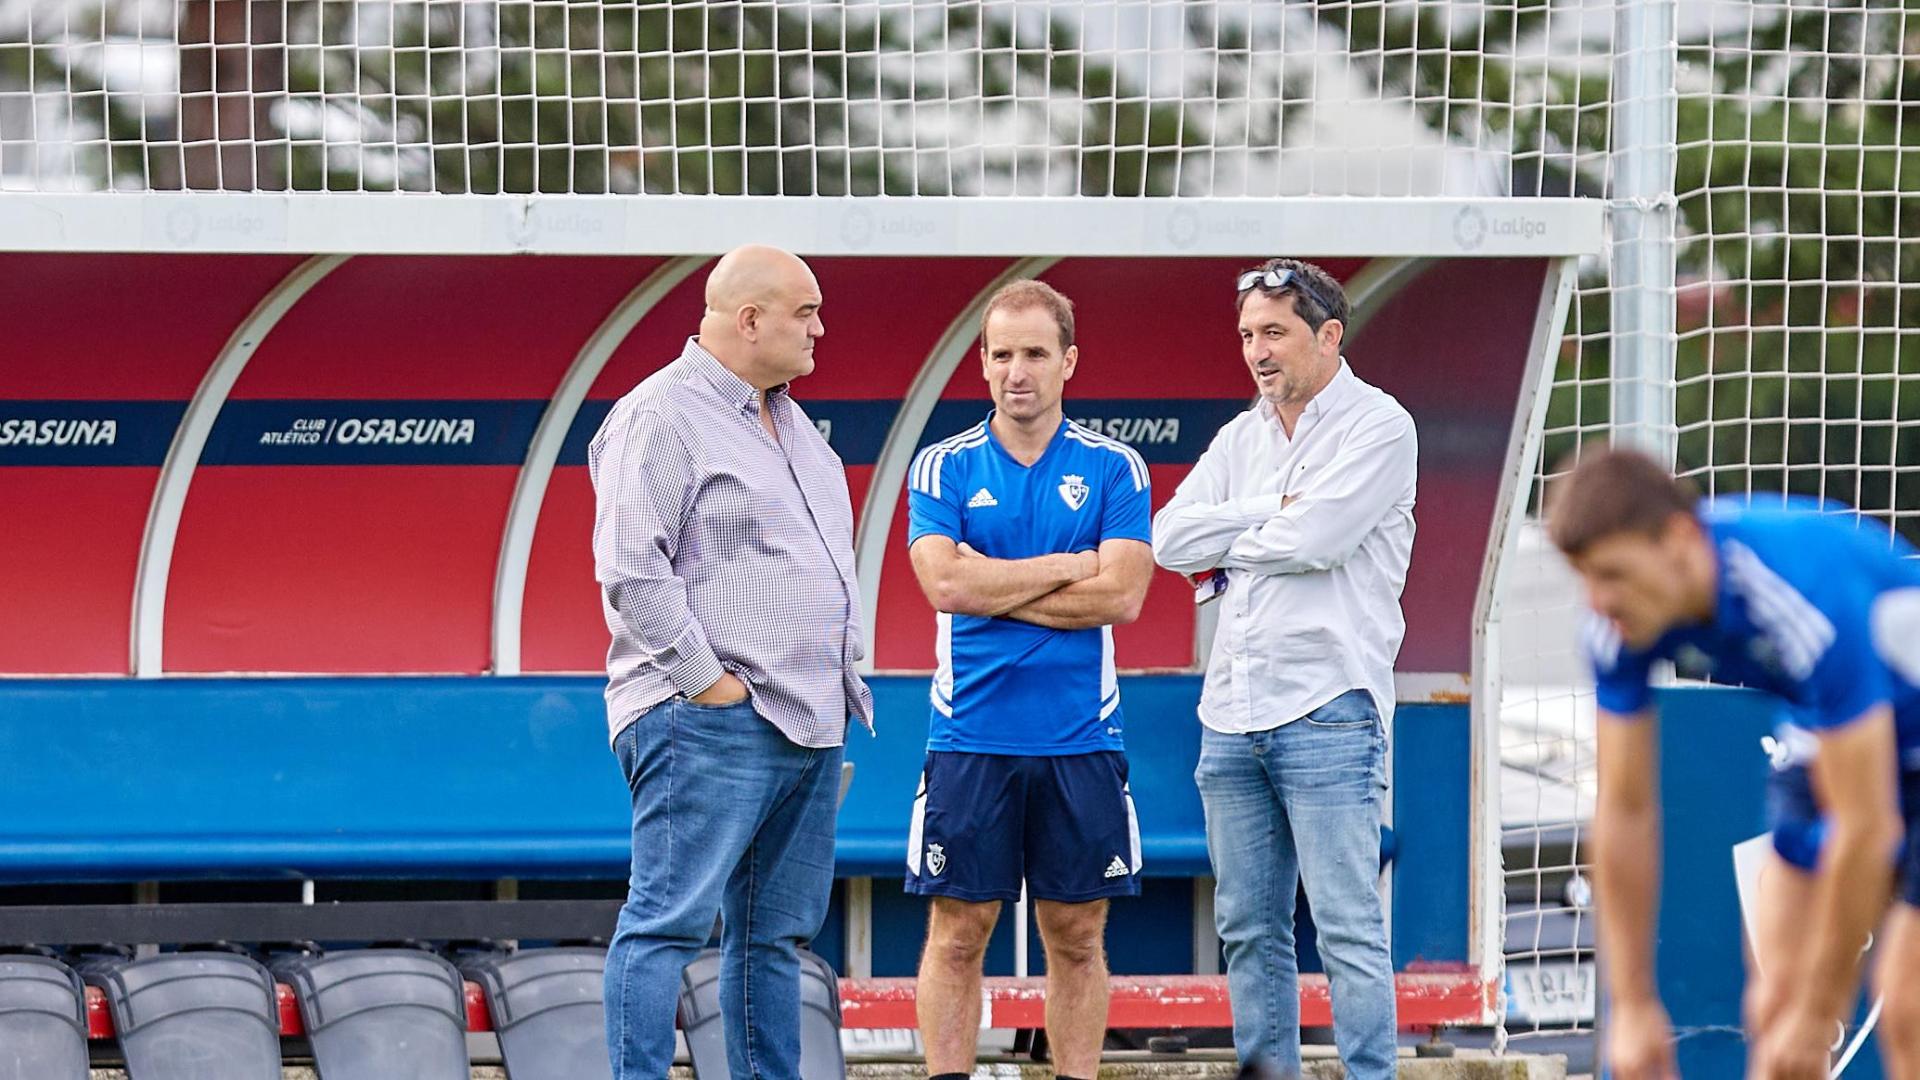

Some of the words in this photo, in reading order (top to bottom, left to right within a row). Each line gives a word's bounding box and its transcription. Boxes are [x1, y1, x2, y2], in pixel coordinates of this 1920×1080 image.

[1493, 216, 1546, 239] LaLiga
[0, 419, 117, 445] SASUNA
[293, 418, 326, 430] CLUB
[337, 418, 475, 445] OSASUNA
[260, 429, 321, 444] ATLÉTICO
